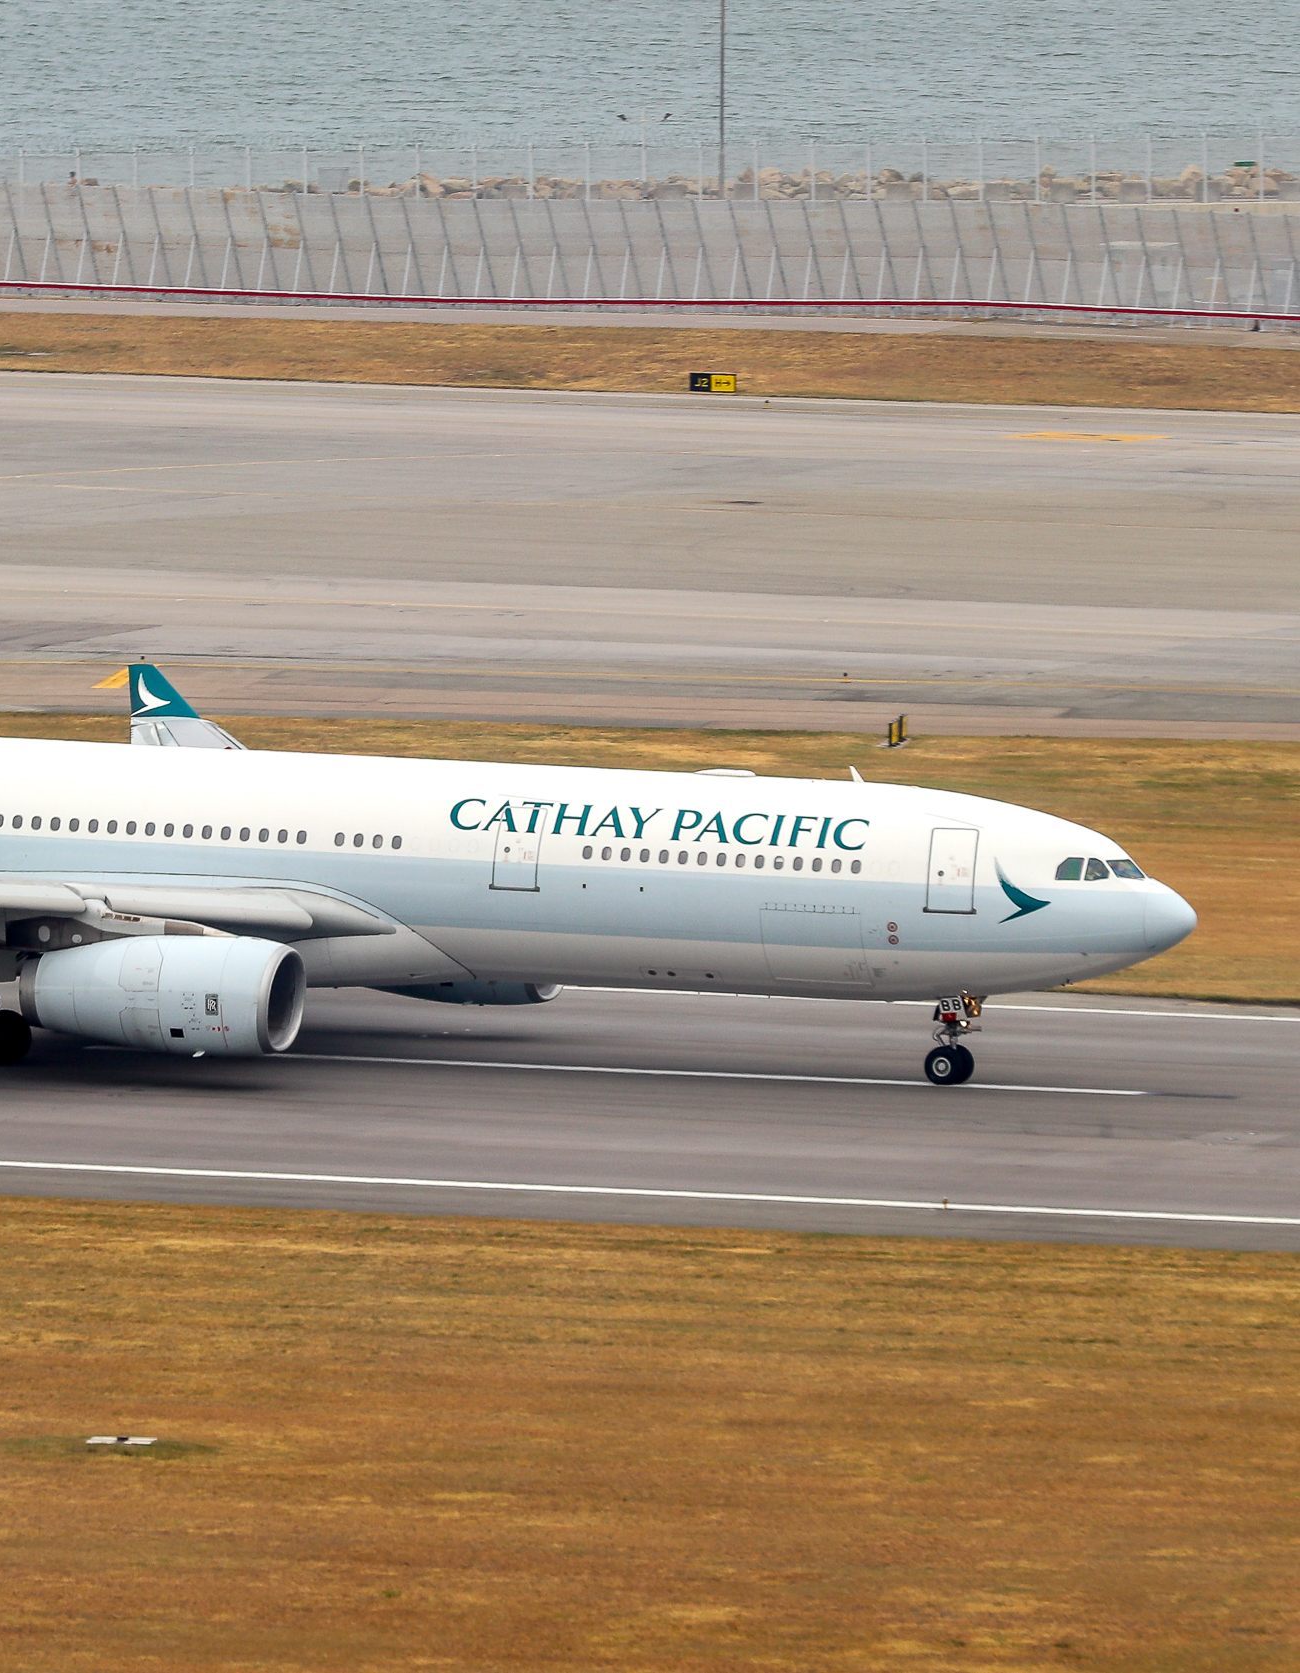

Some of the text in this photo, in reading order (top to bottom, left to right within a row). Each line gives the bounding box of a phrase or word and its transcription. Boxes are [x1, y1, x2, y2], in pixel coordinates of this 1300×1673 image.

[694, 378, 709, 387] J2
[450, 797, 871, 851] CATHAY PACIFIC
[941, 999, 962, 1012] BB
